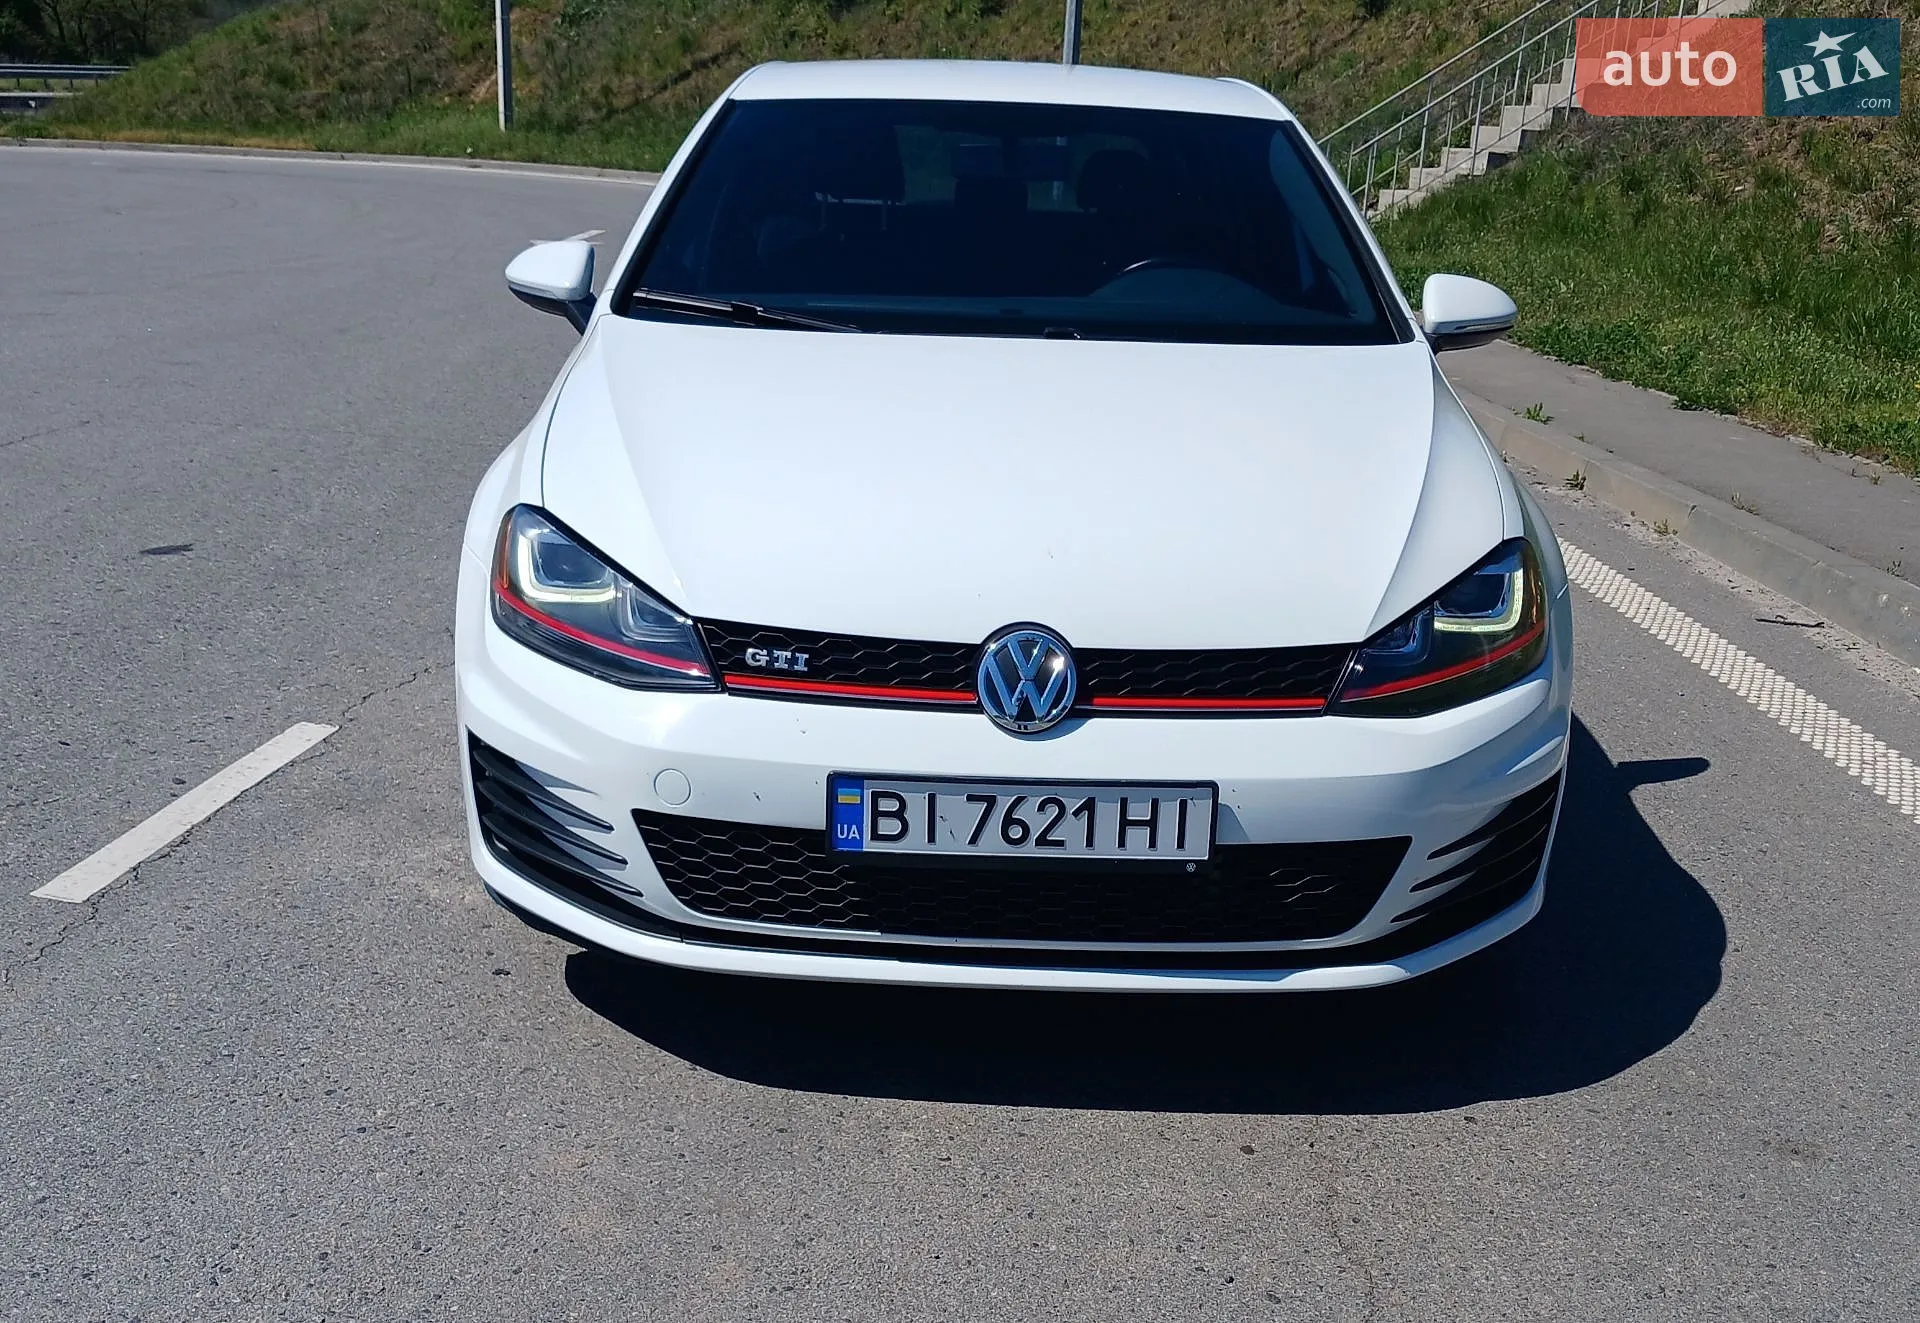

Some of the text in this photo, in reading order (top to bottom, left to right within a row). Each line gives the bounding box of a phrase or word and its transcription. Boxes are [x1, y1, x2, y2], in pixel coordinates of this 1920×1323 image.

[745, 647, 810, 672] GTI
[837, 823, 860, 840] UA
[965, 793, 1097, 849] 7621
